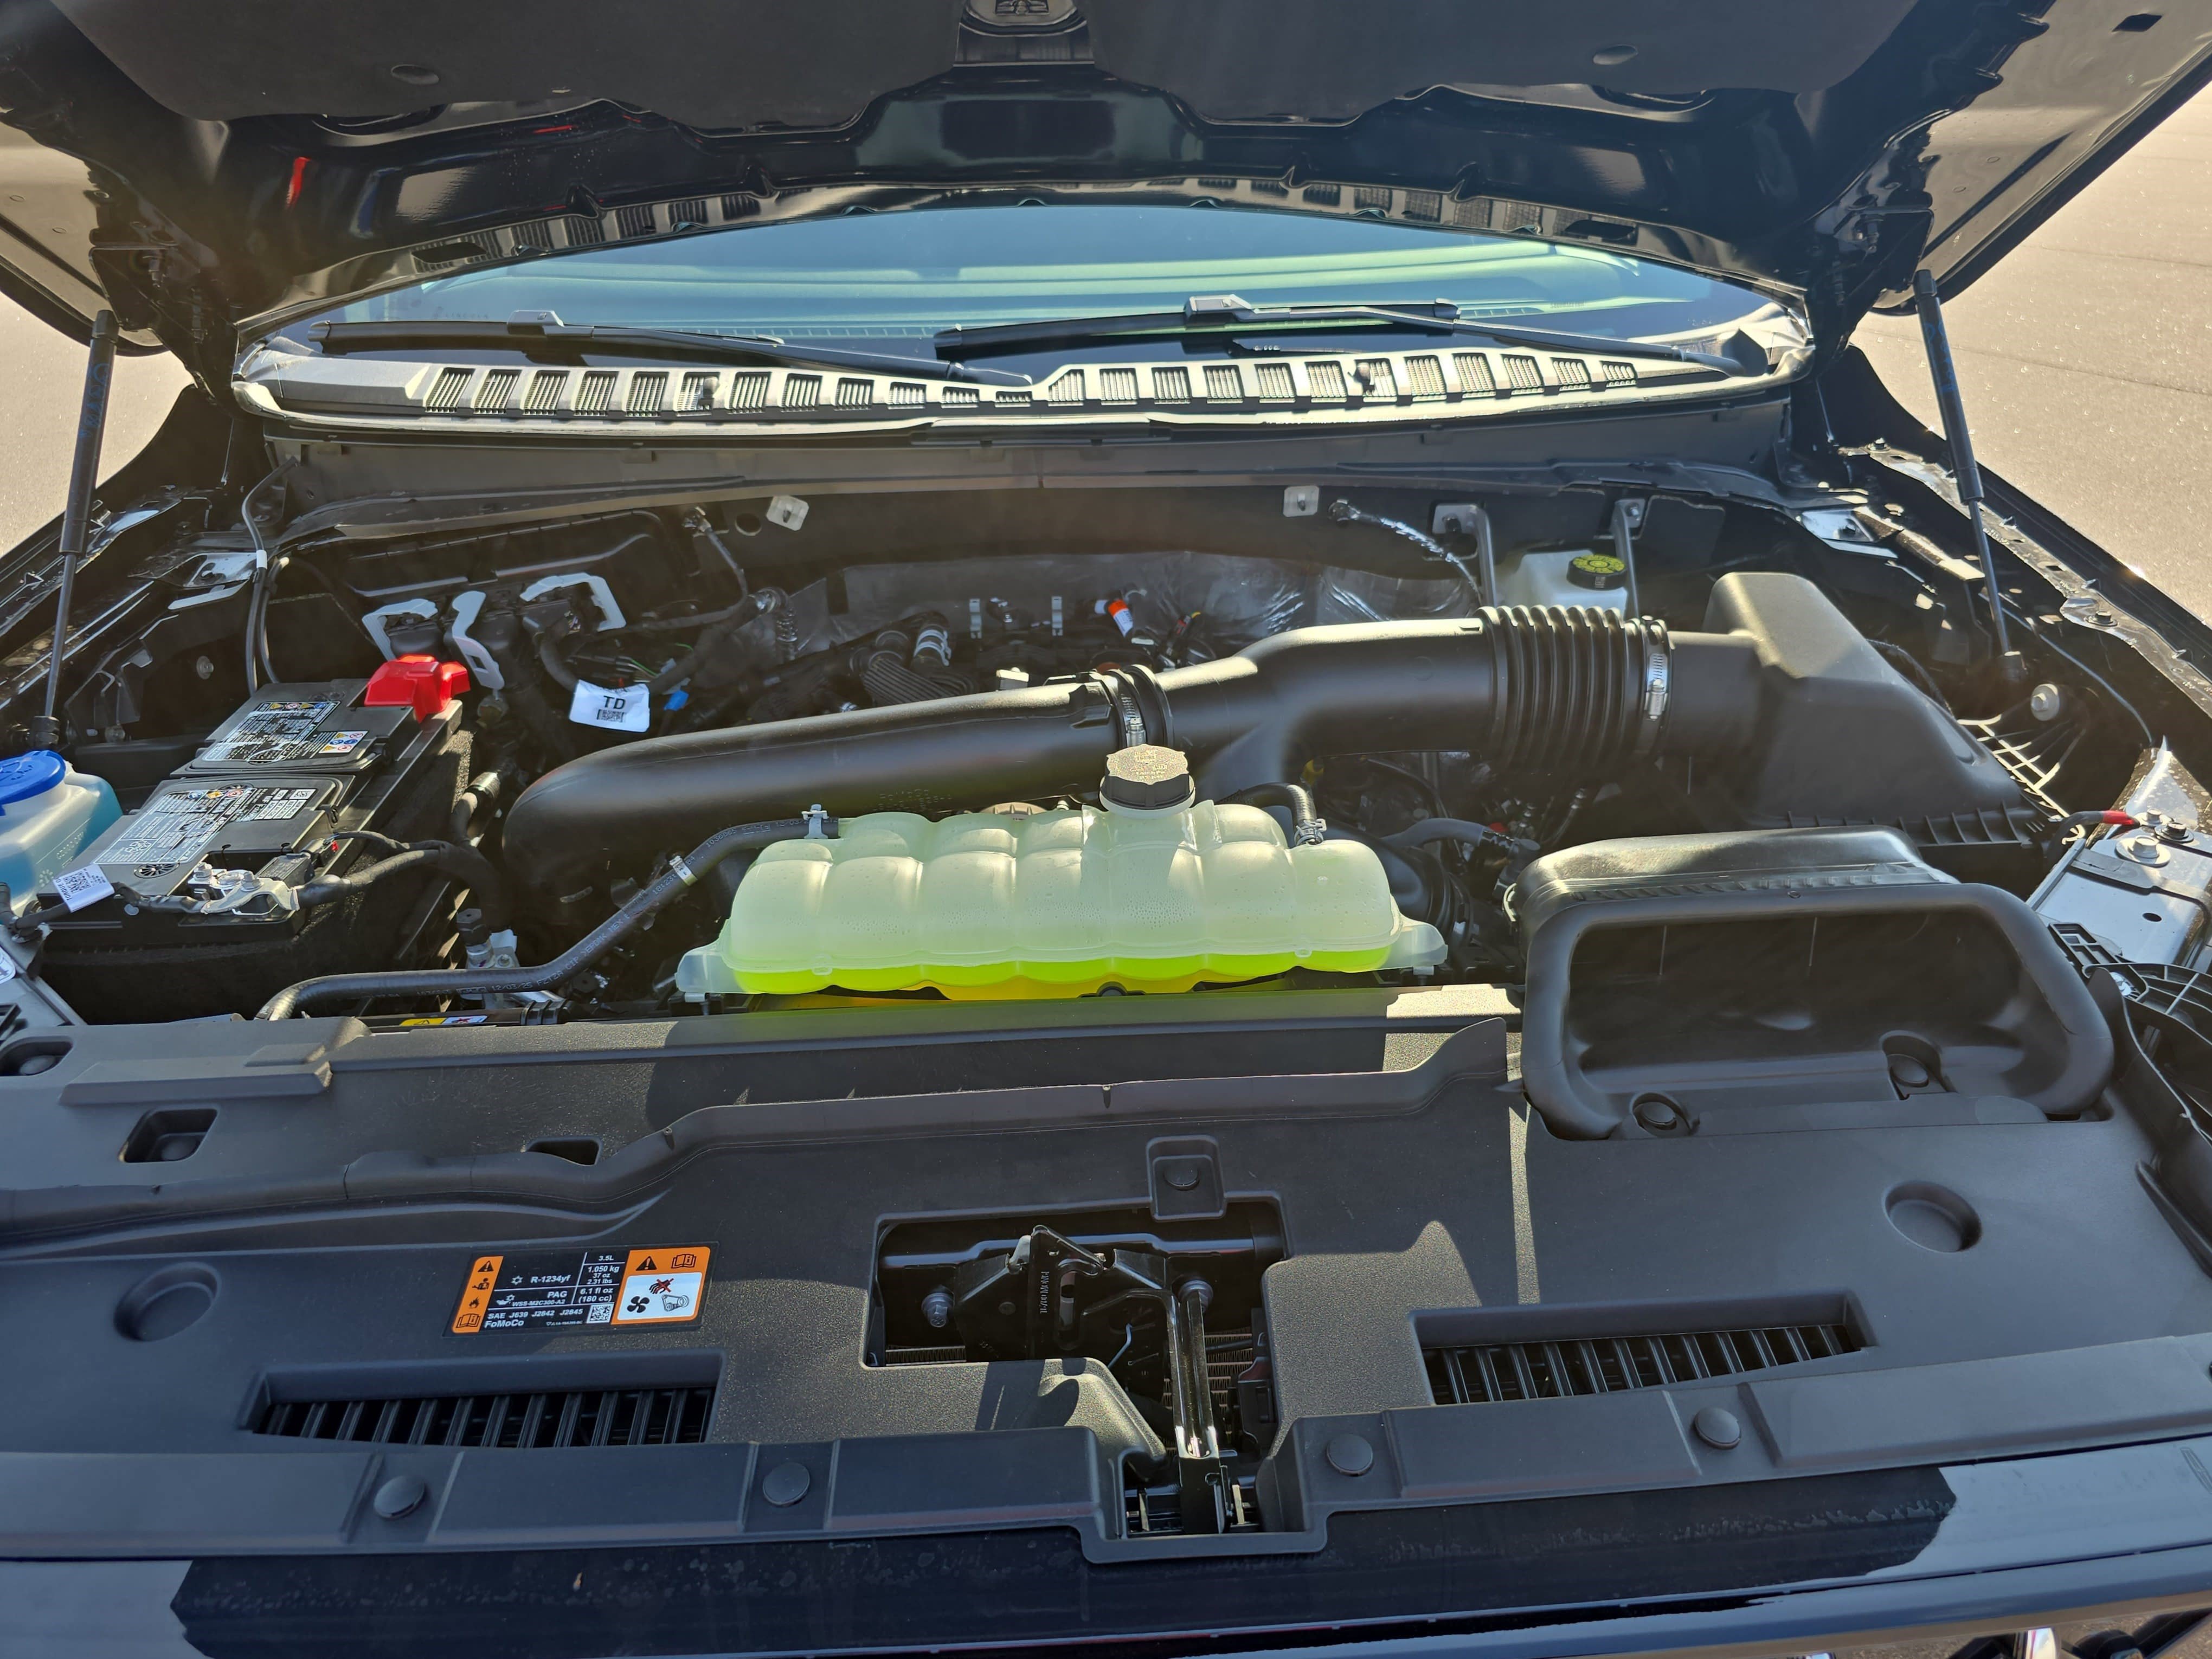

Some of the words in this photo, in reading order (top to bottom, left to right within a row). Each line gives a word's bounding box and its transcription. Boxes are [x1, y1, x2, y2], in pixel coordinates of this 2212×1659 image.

[603, 696, 626, 710] TD
[58, 884, 72, 901] TORQUE
[530, 1275, 571, 1283] R-1234yf
[578, 1295, 597, 1303] (180
[484, 1319, 524, 1328] FoMoCo
